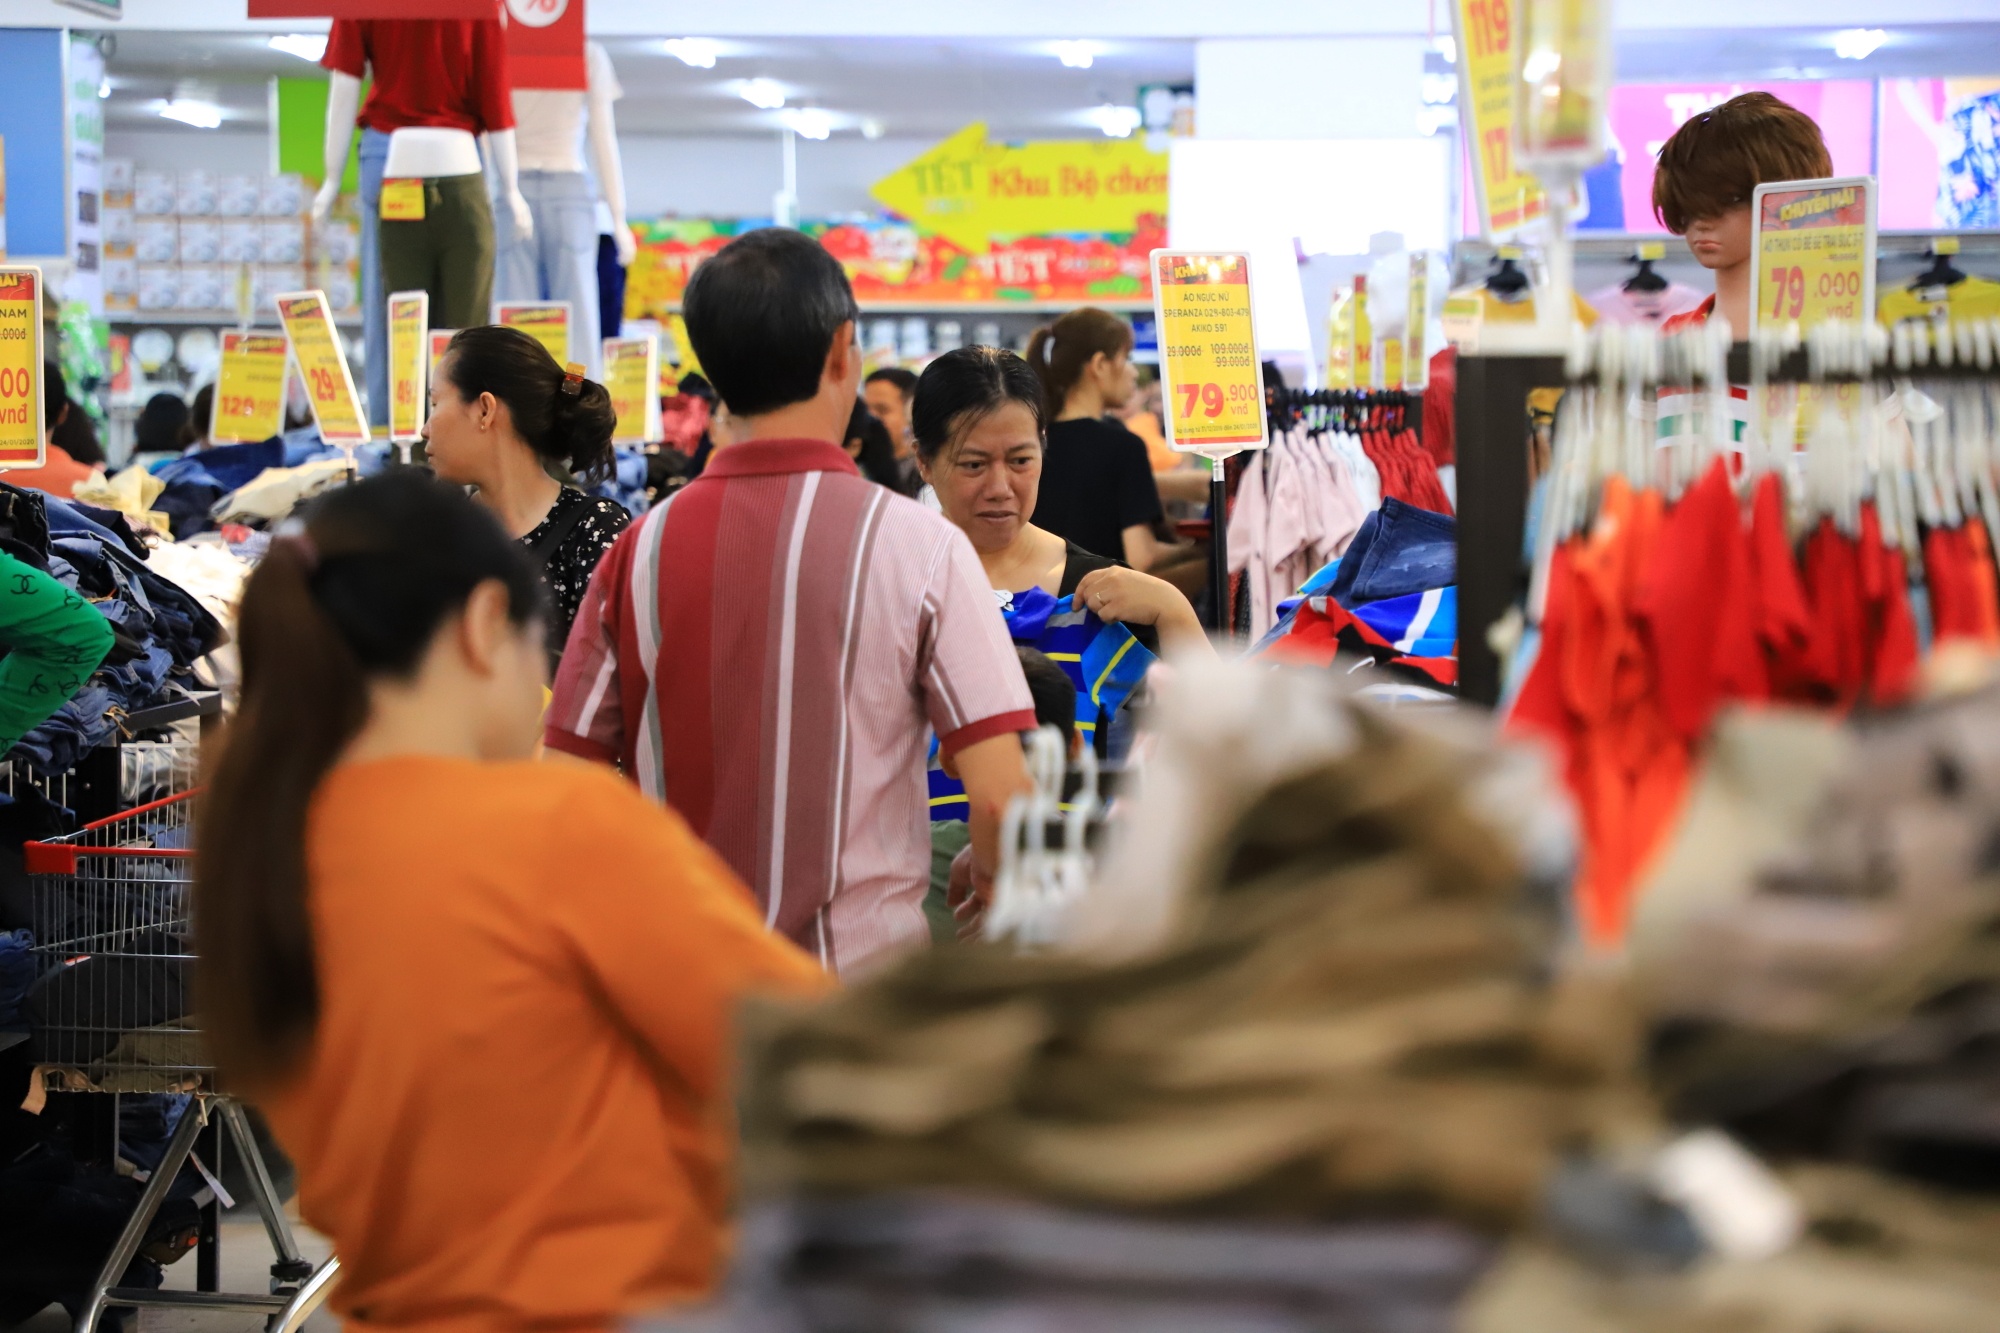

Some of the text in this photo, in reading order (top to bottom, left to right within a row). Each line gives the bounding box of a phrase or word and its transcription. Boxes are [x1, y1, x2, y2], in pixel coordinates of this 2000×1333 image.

[989, 166, 1050, 198] Khu
[1771, 265, 1805, 320] 79
[1164, 308, 1204, 318] SPERANZA
[1191, 323, 1228, 333] AKIKO 591
[1210, 343, 1249, 355] 109.000đ
[1215, 356, 1250, 367] 99.000đ
[1230, 403, 1249, 415] vnđ
